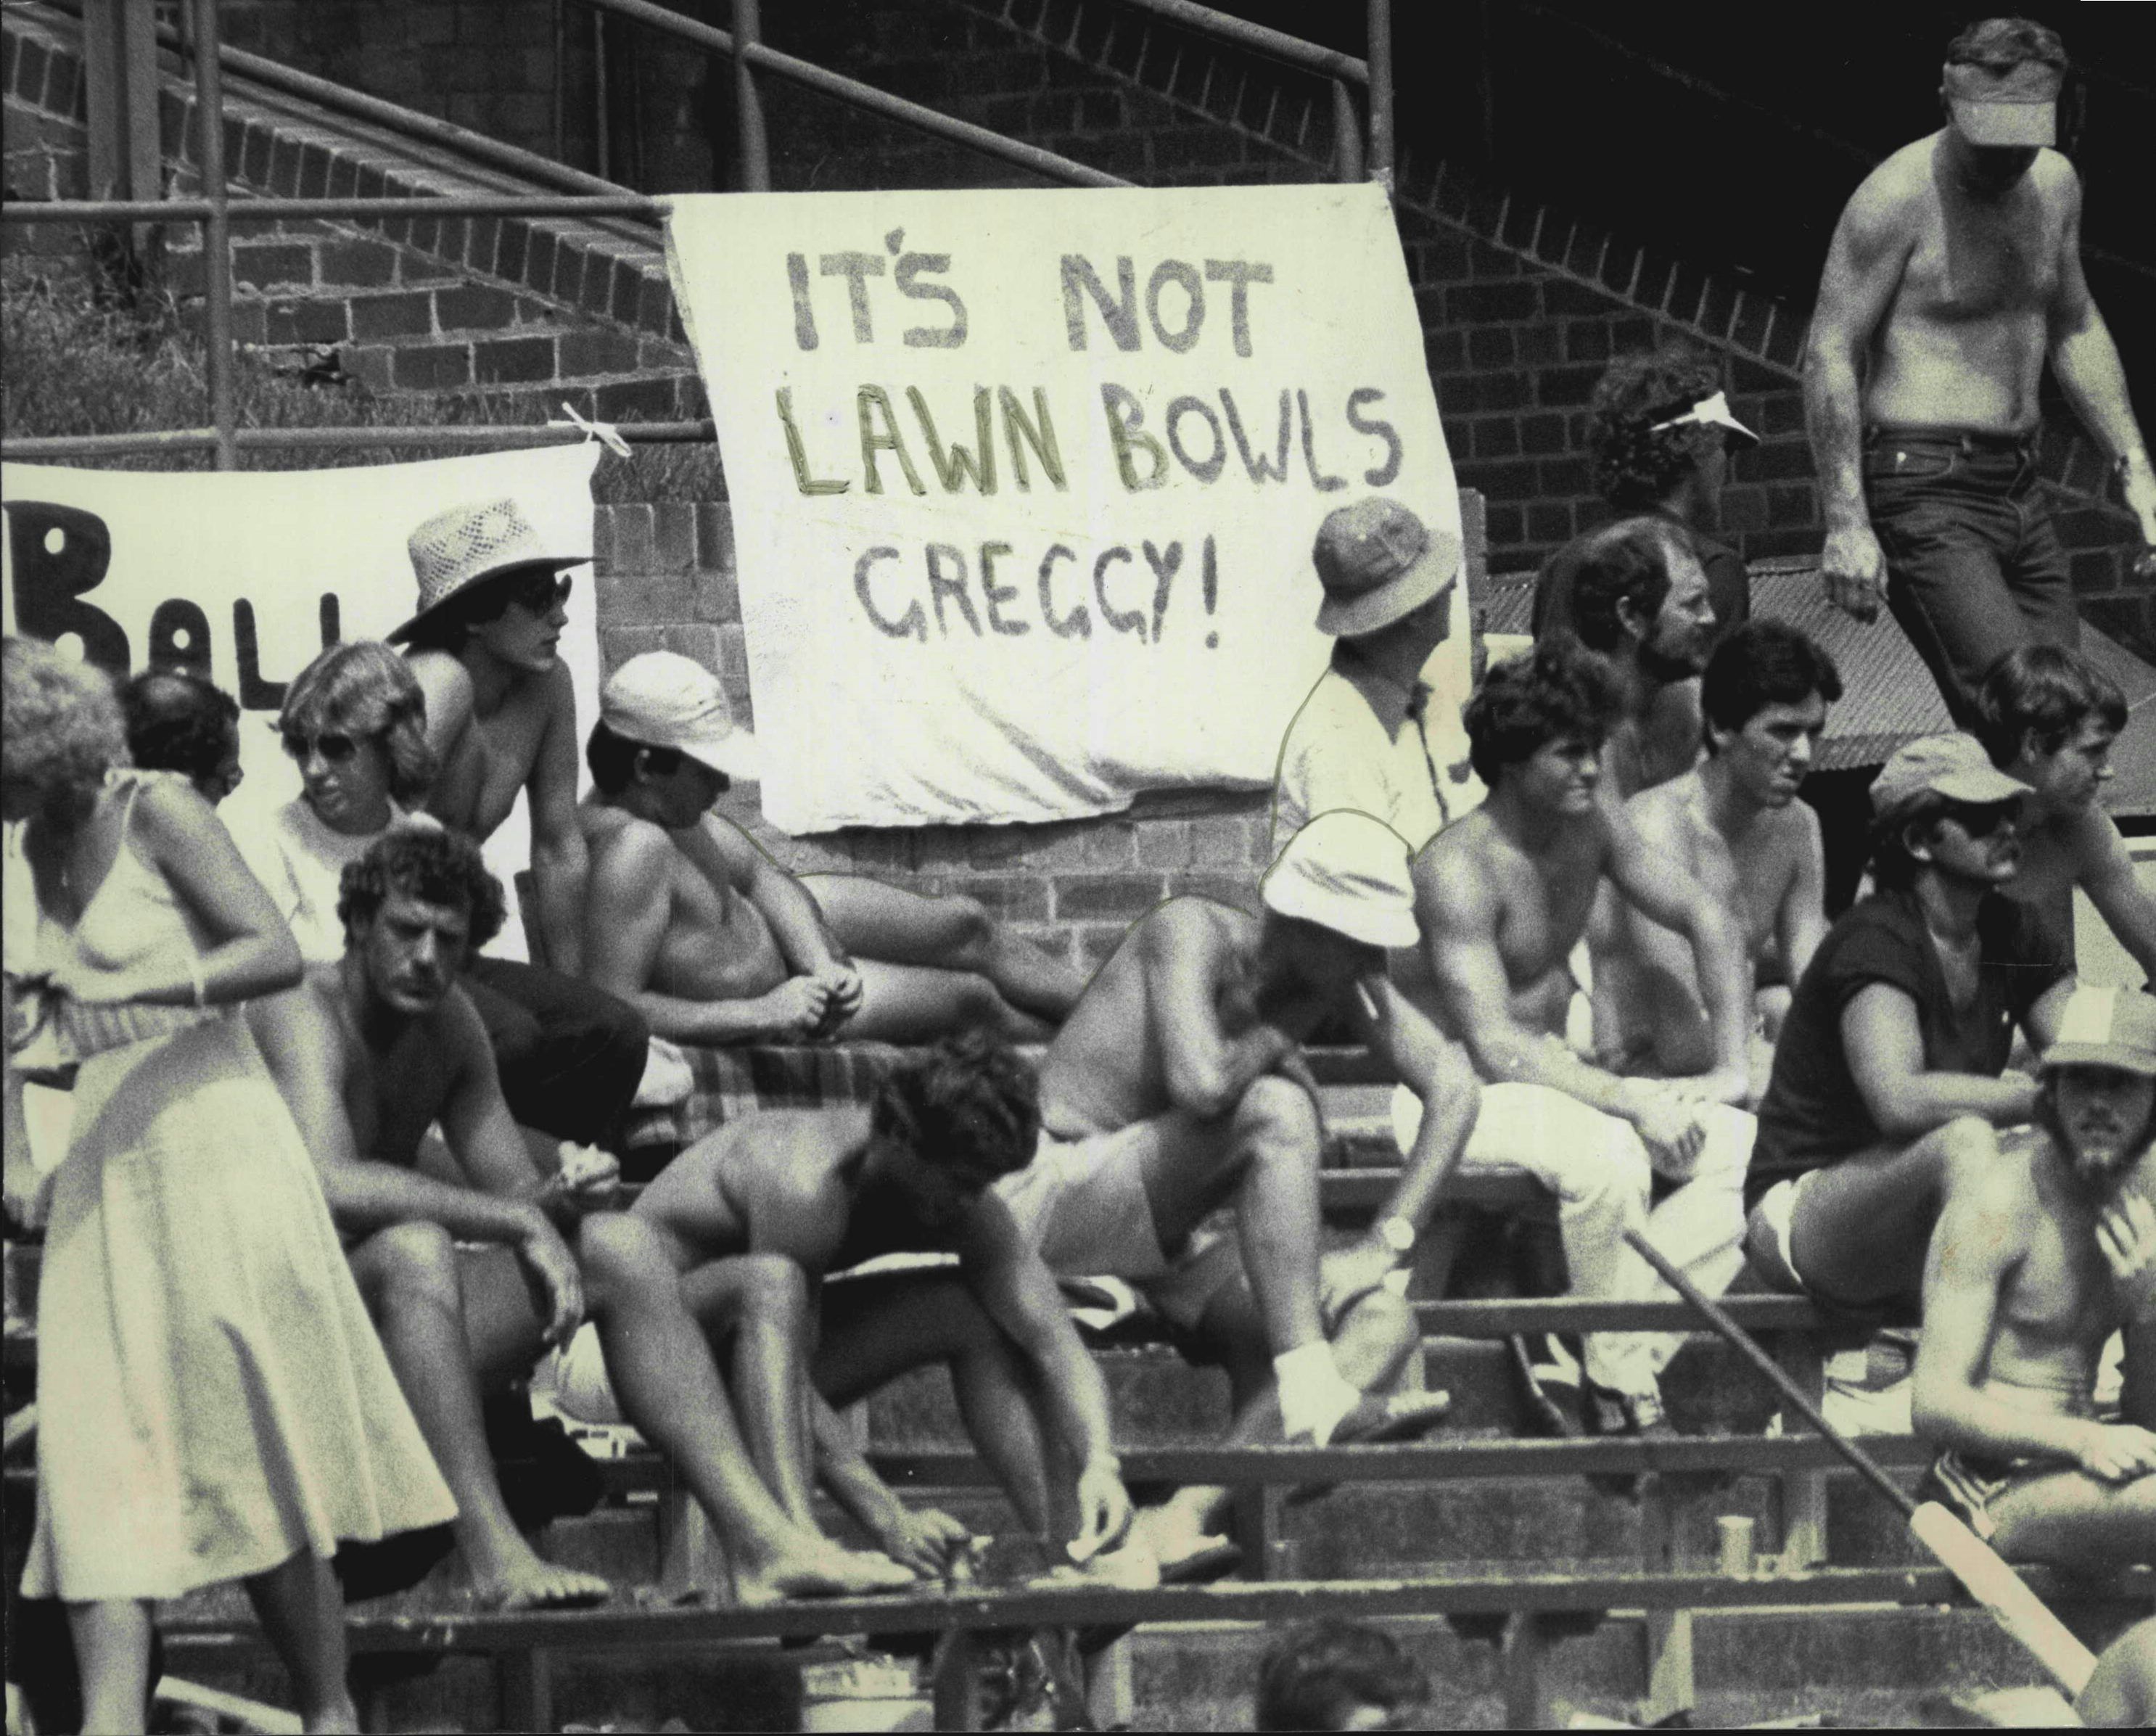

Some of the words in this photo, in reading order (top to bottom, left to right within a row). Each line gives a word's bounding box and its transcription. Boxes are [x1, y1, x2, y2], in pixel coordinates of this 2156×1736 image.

[786, 226, 968, 352] IT'S
[1060, 252, 1275, 358] NOT
[775, 383, 1069, 497] LAWN
[1101, 383, 1405, 493] BOWLS
[853, 533, 1219, 649] GREGGY!
